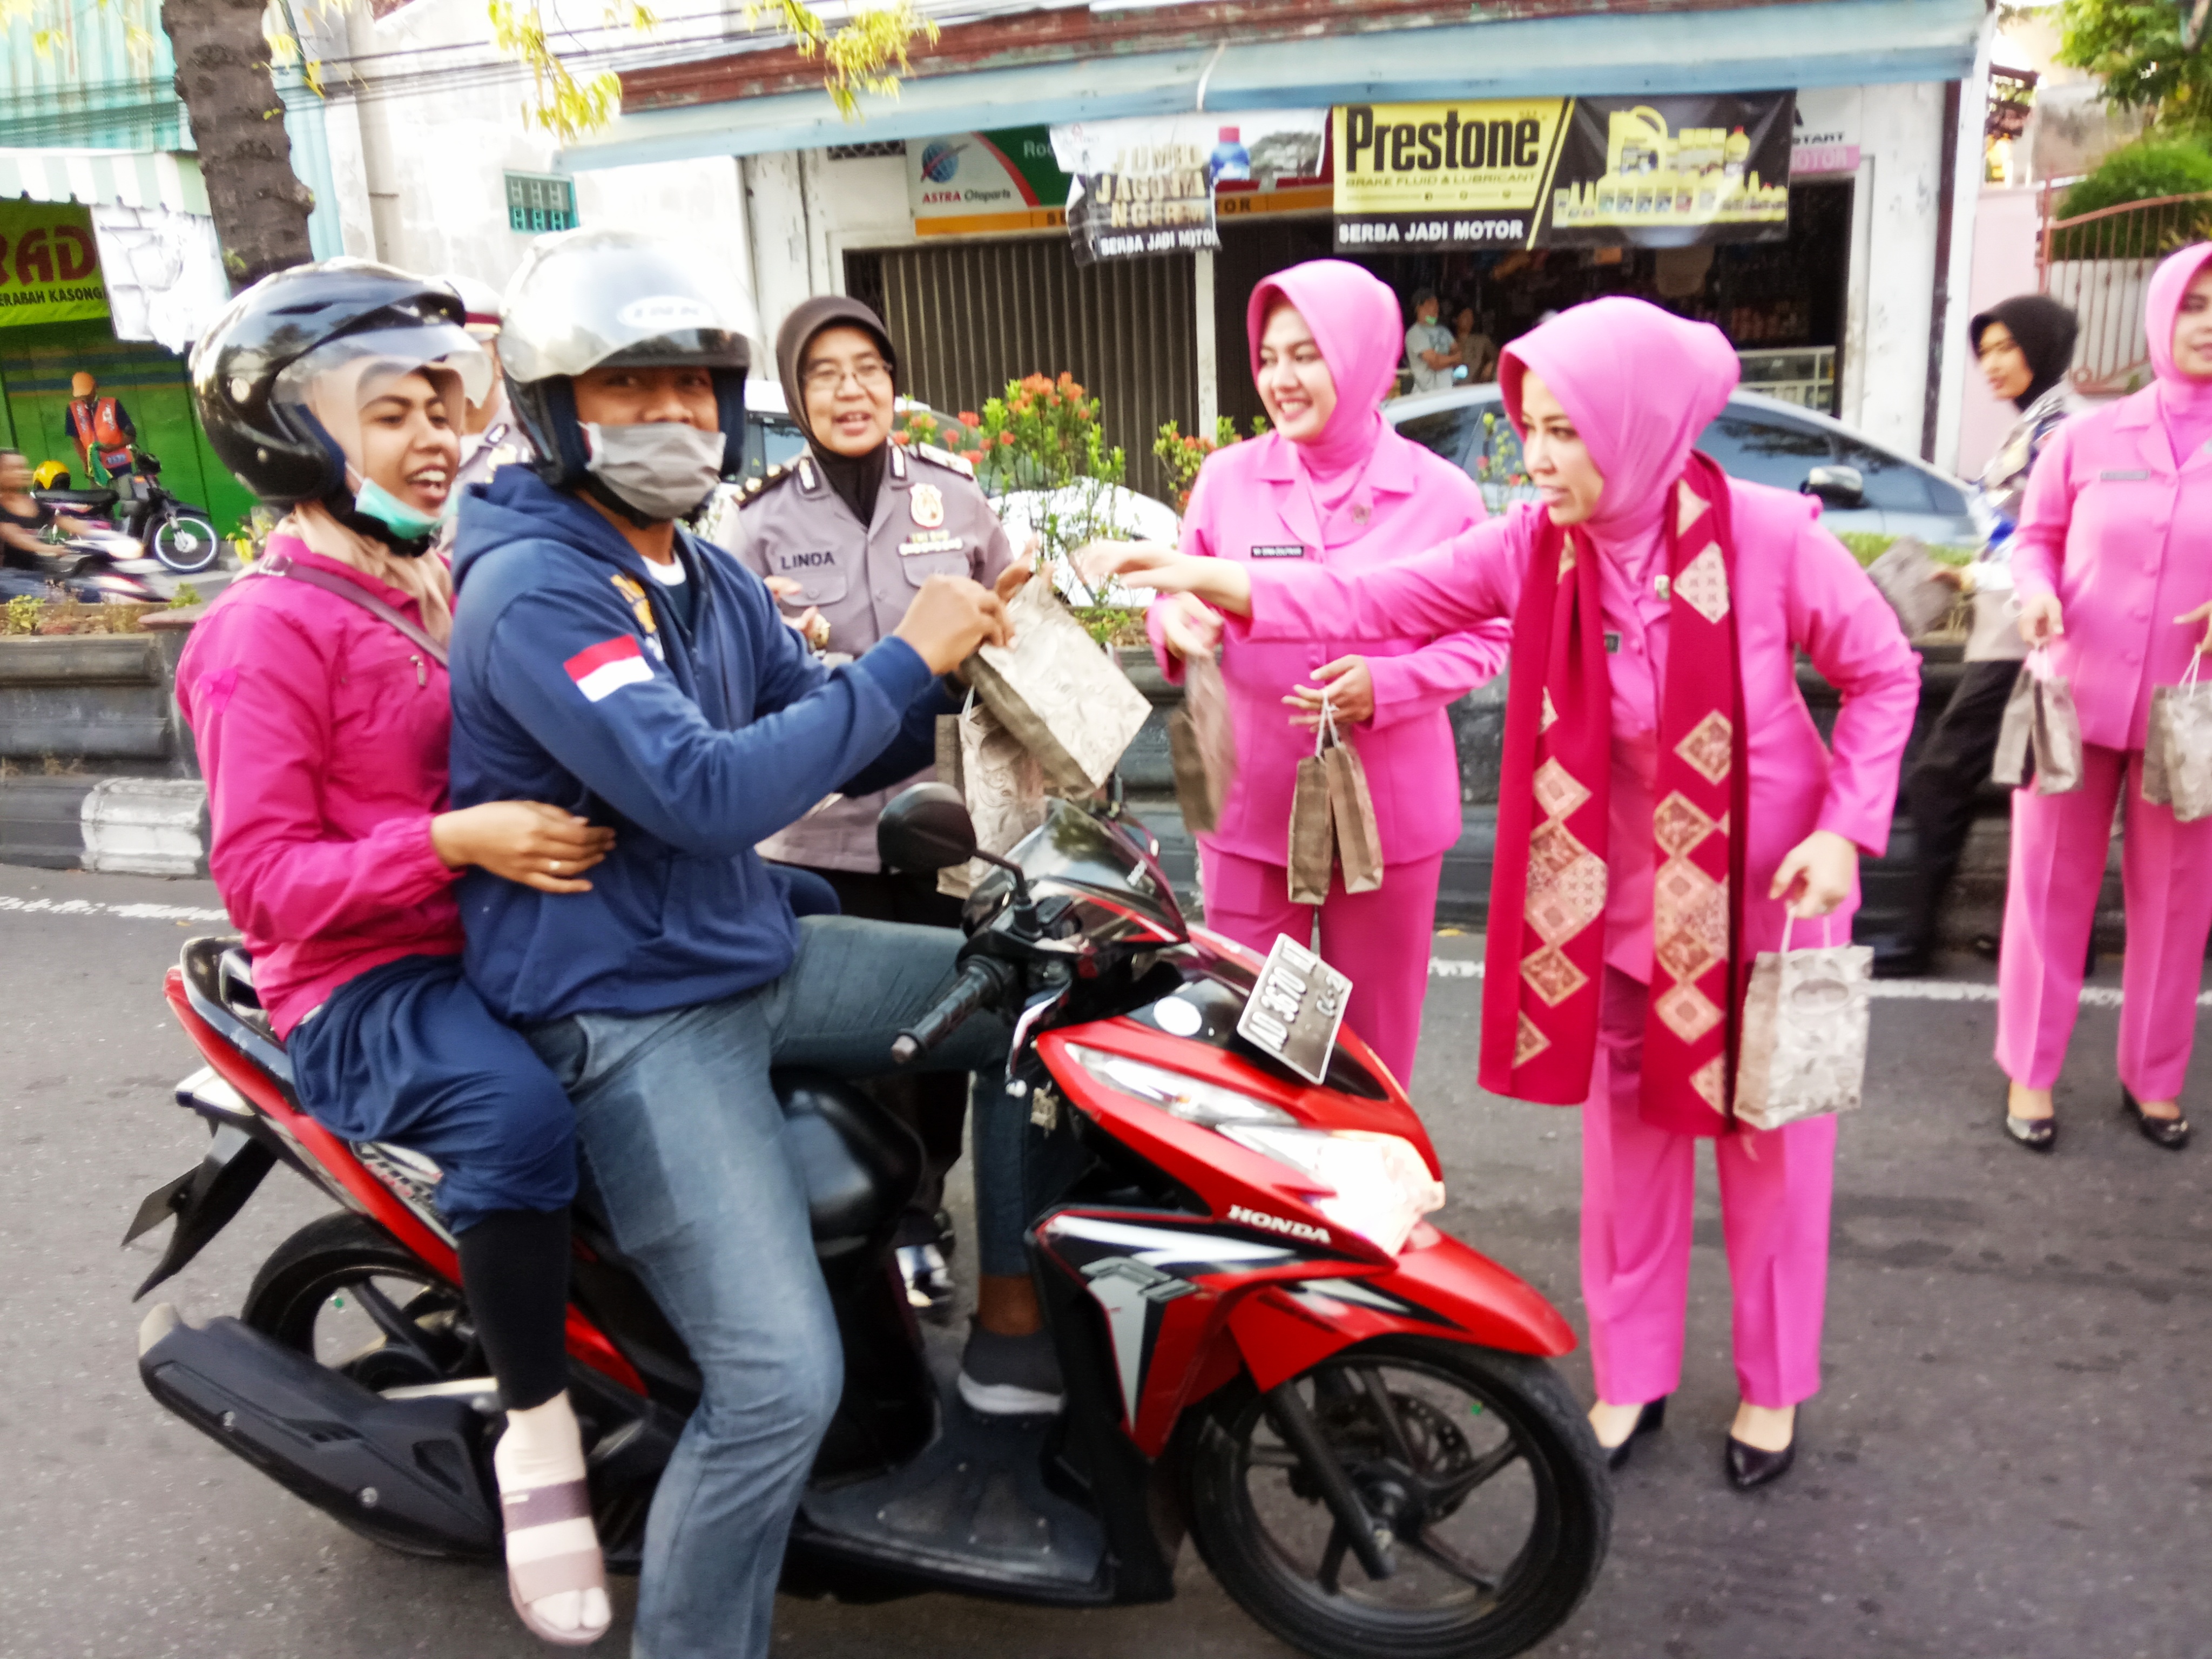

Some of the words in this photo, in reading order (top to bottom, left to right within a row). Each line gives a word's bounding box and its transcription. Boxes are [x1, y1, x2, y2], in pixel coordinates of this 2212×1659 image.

[1347, 105, 1540, 173] Prestone
[1346, 177, 1392, 188] BRAKE
[1397, 176, 1437, 187] FLUID
[922, 191, 962, 204] ASTRA
[1339, 222, 1400, 243] SERBA
[1405, 221, 1448, 241] JADI
[1454, 219, 1523, 240] MOTOR
[780, 551, 835, 570] LINDA
[1229, 1204, 1331, 1244] HONDA
